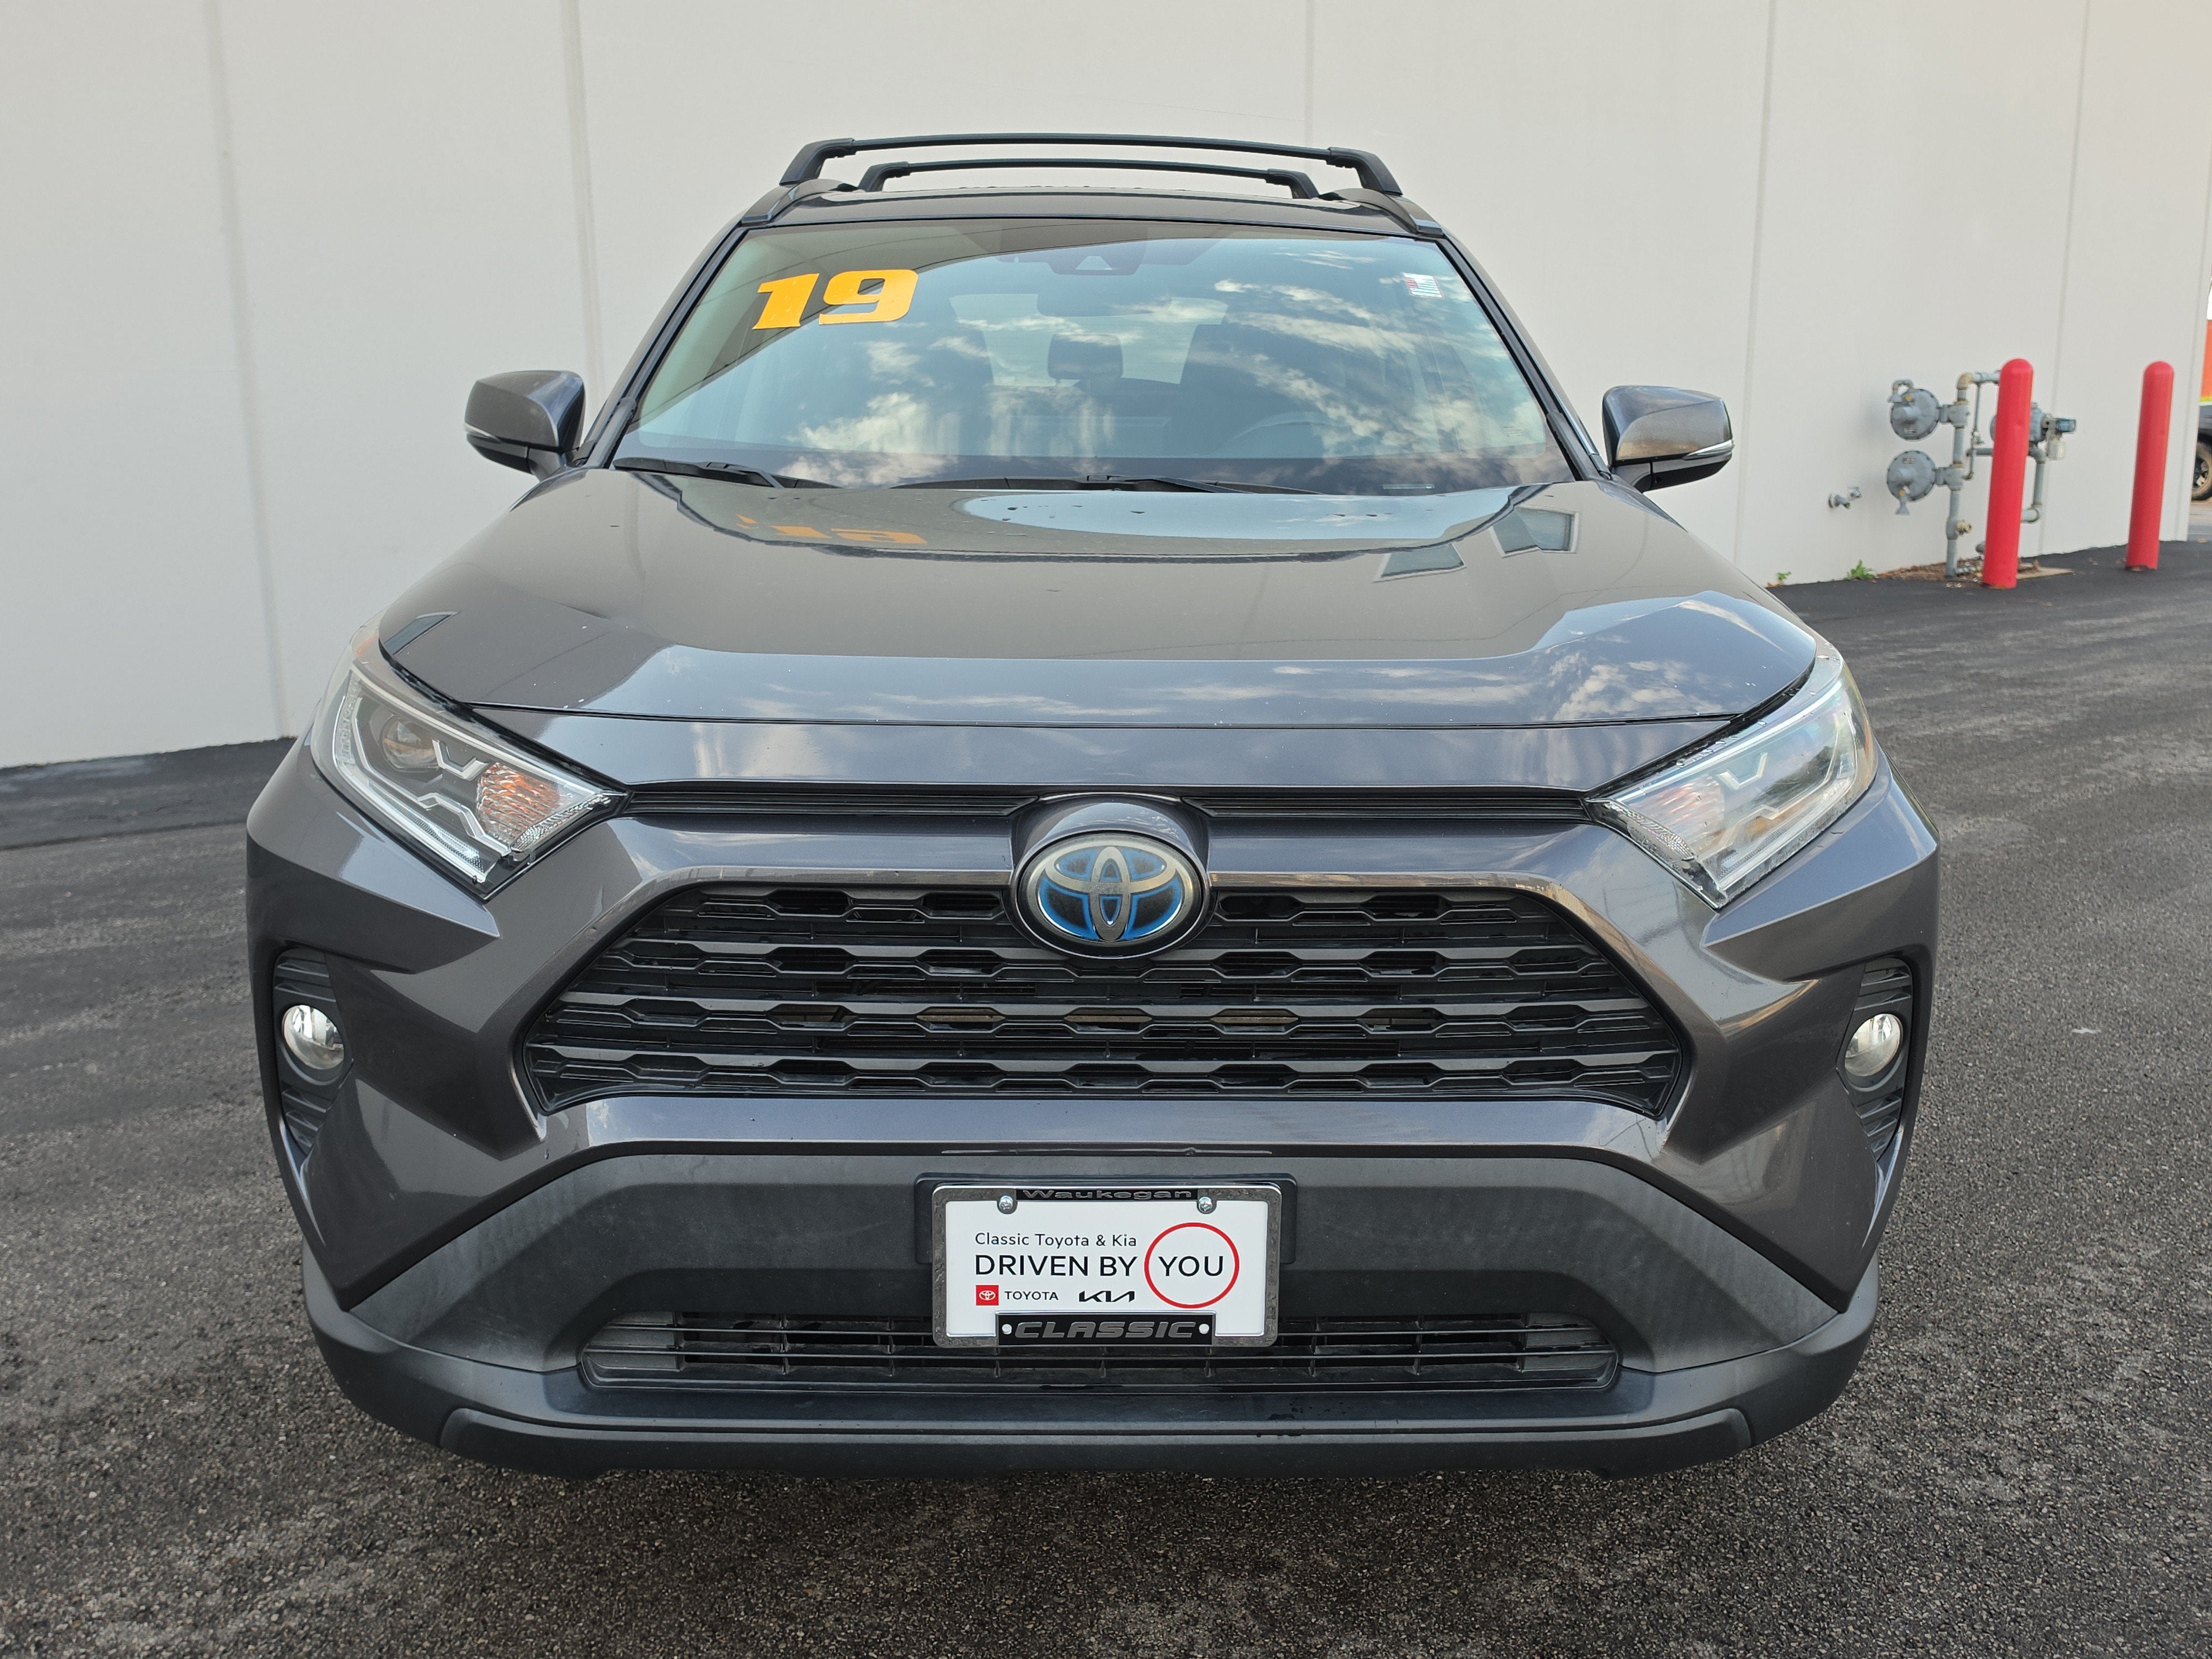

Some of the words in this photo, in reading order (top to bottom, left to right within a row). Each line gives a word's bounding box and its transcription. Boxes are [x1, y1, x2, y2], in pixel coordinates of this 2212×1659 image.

[752, 269, 918, 330] 19
[1023, 1189, 1192, 1200] Waukegan
[975, 1232, 1030, 1246] Classic
[1034, 1233, 1089, 1249] Toyota
[1096, 1234, 1106, 1246] &
[1112, 1233, 1136, 1247] Kia
[975, 1255, 1088, 1276] DRIVEN
[1101, 1256, 1138, 1276] BY
[1158, 1256, 1224, 1277] YOU
[1005, 1291, 1059, 1301] TOYOTA
[1014, 1322, 1196, 1339] CLASSIC
